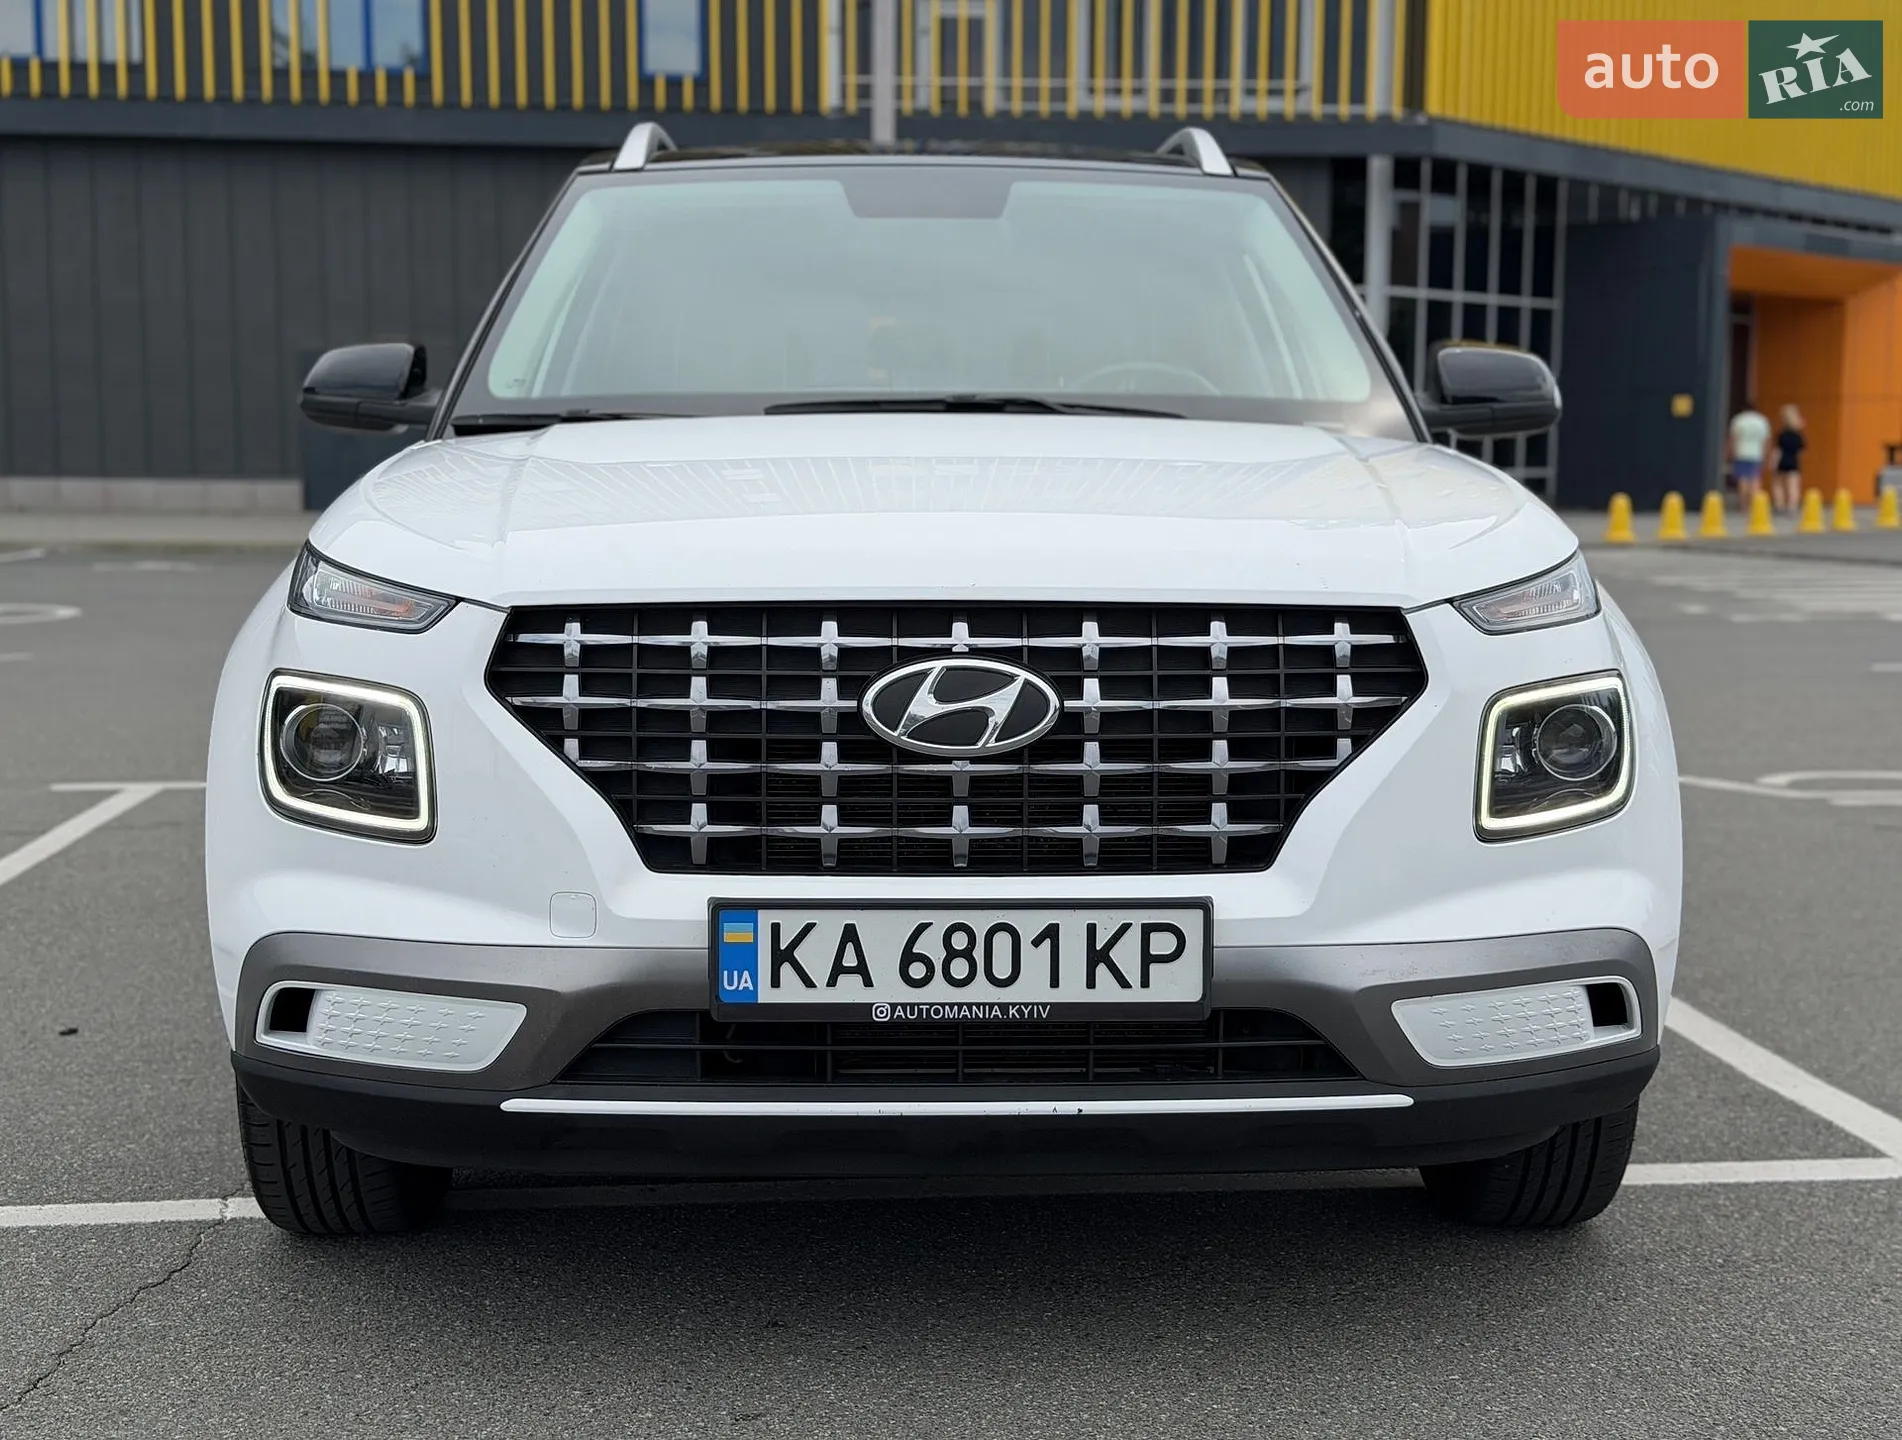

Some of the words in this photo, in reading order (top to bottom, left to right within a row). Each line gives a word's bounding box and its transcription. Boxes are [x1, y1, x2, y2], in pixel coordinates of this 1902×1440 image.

[769, 921, 875, 989] KA
[898, 921, 1060, 989] 6801
[1085, 921, 1187, 989] KP
[723, 970, 754, 991] UA
[893, 1004, 1051, 1019] AUTOMANIA.KYIV
